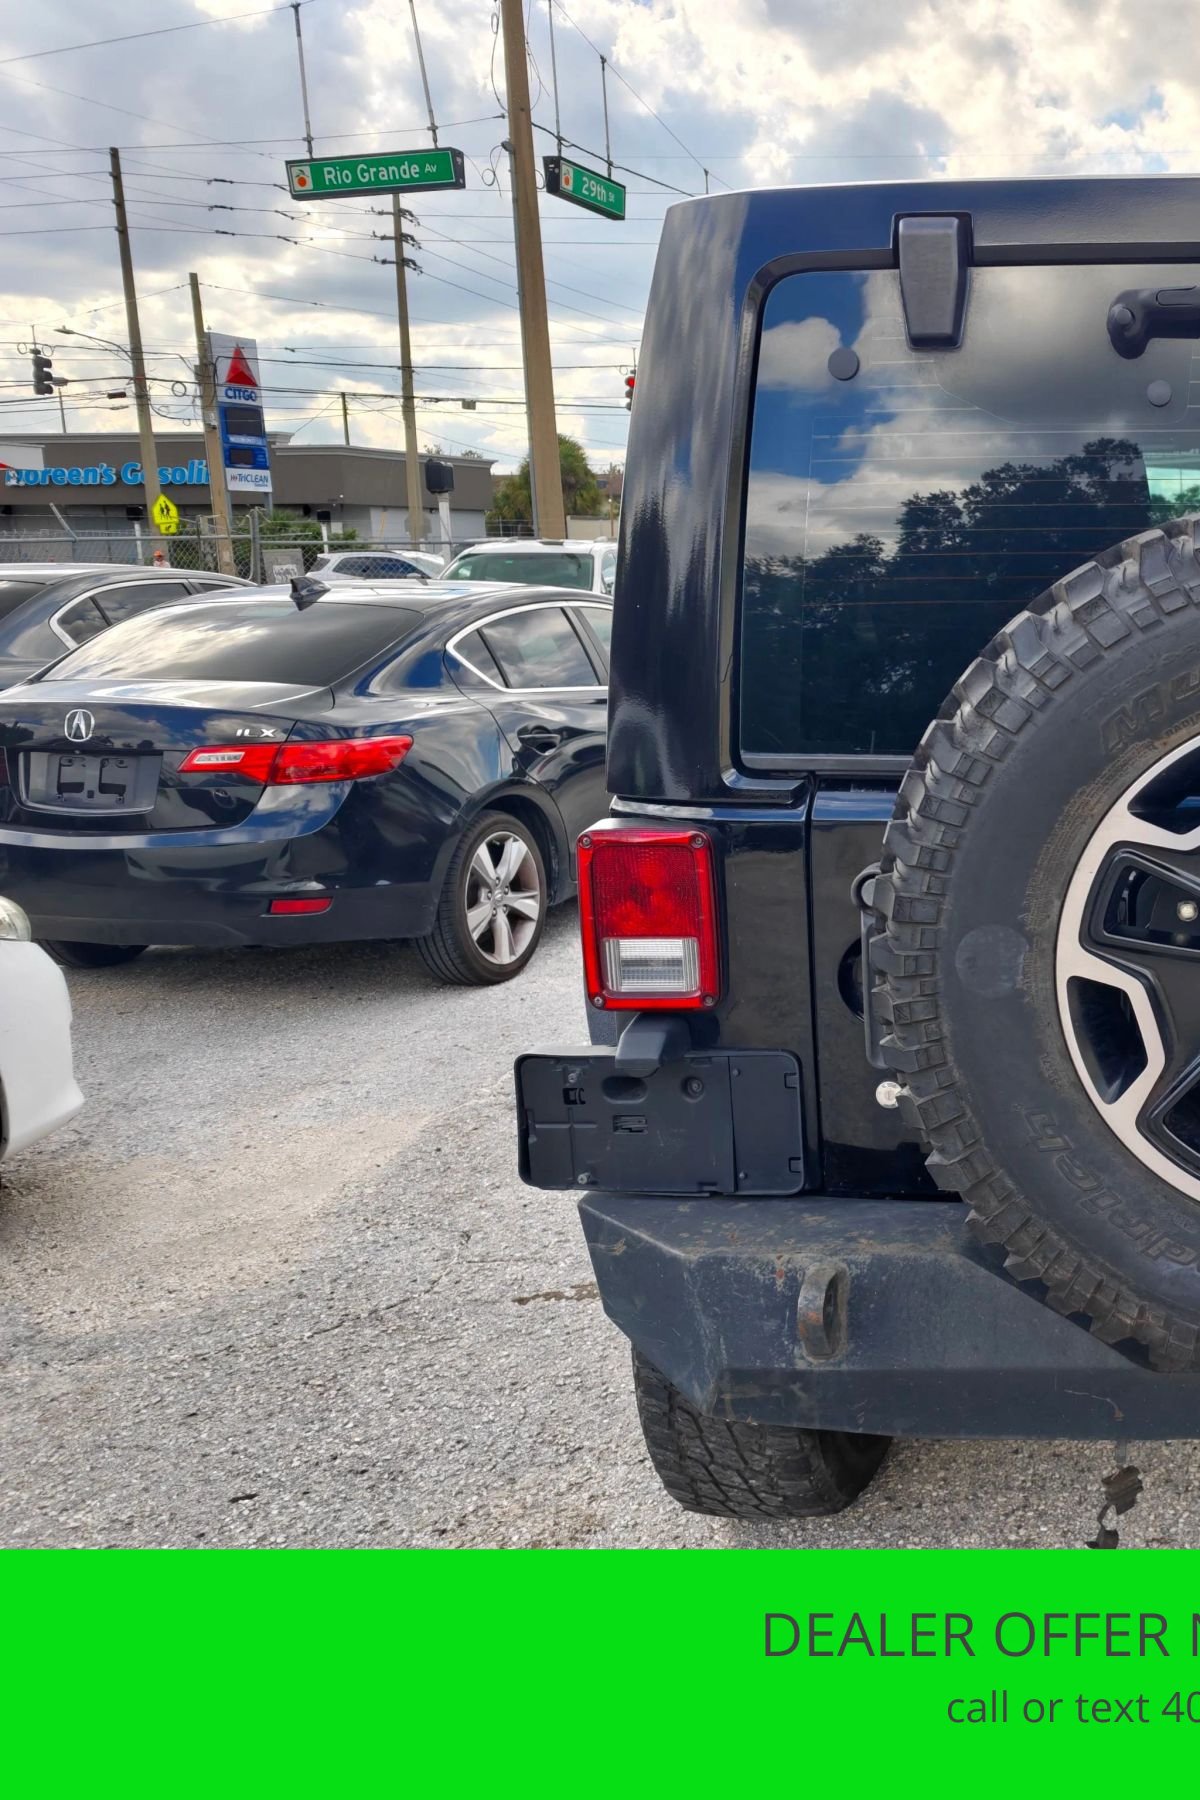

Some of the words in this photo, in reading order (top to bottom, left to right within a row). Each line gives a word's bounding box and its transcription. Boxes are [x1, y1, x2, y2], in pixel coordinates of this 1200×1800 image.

[323, 166, 352, 185] Rio
[357, 161, 420, 183] Grande
[424, 163, 437, 174] Av
[582, 176, 607, 203] 29th
[224, 387, 257, 401] CITGO
